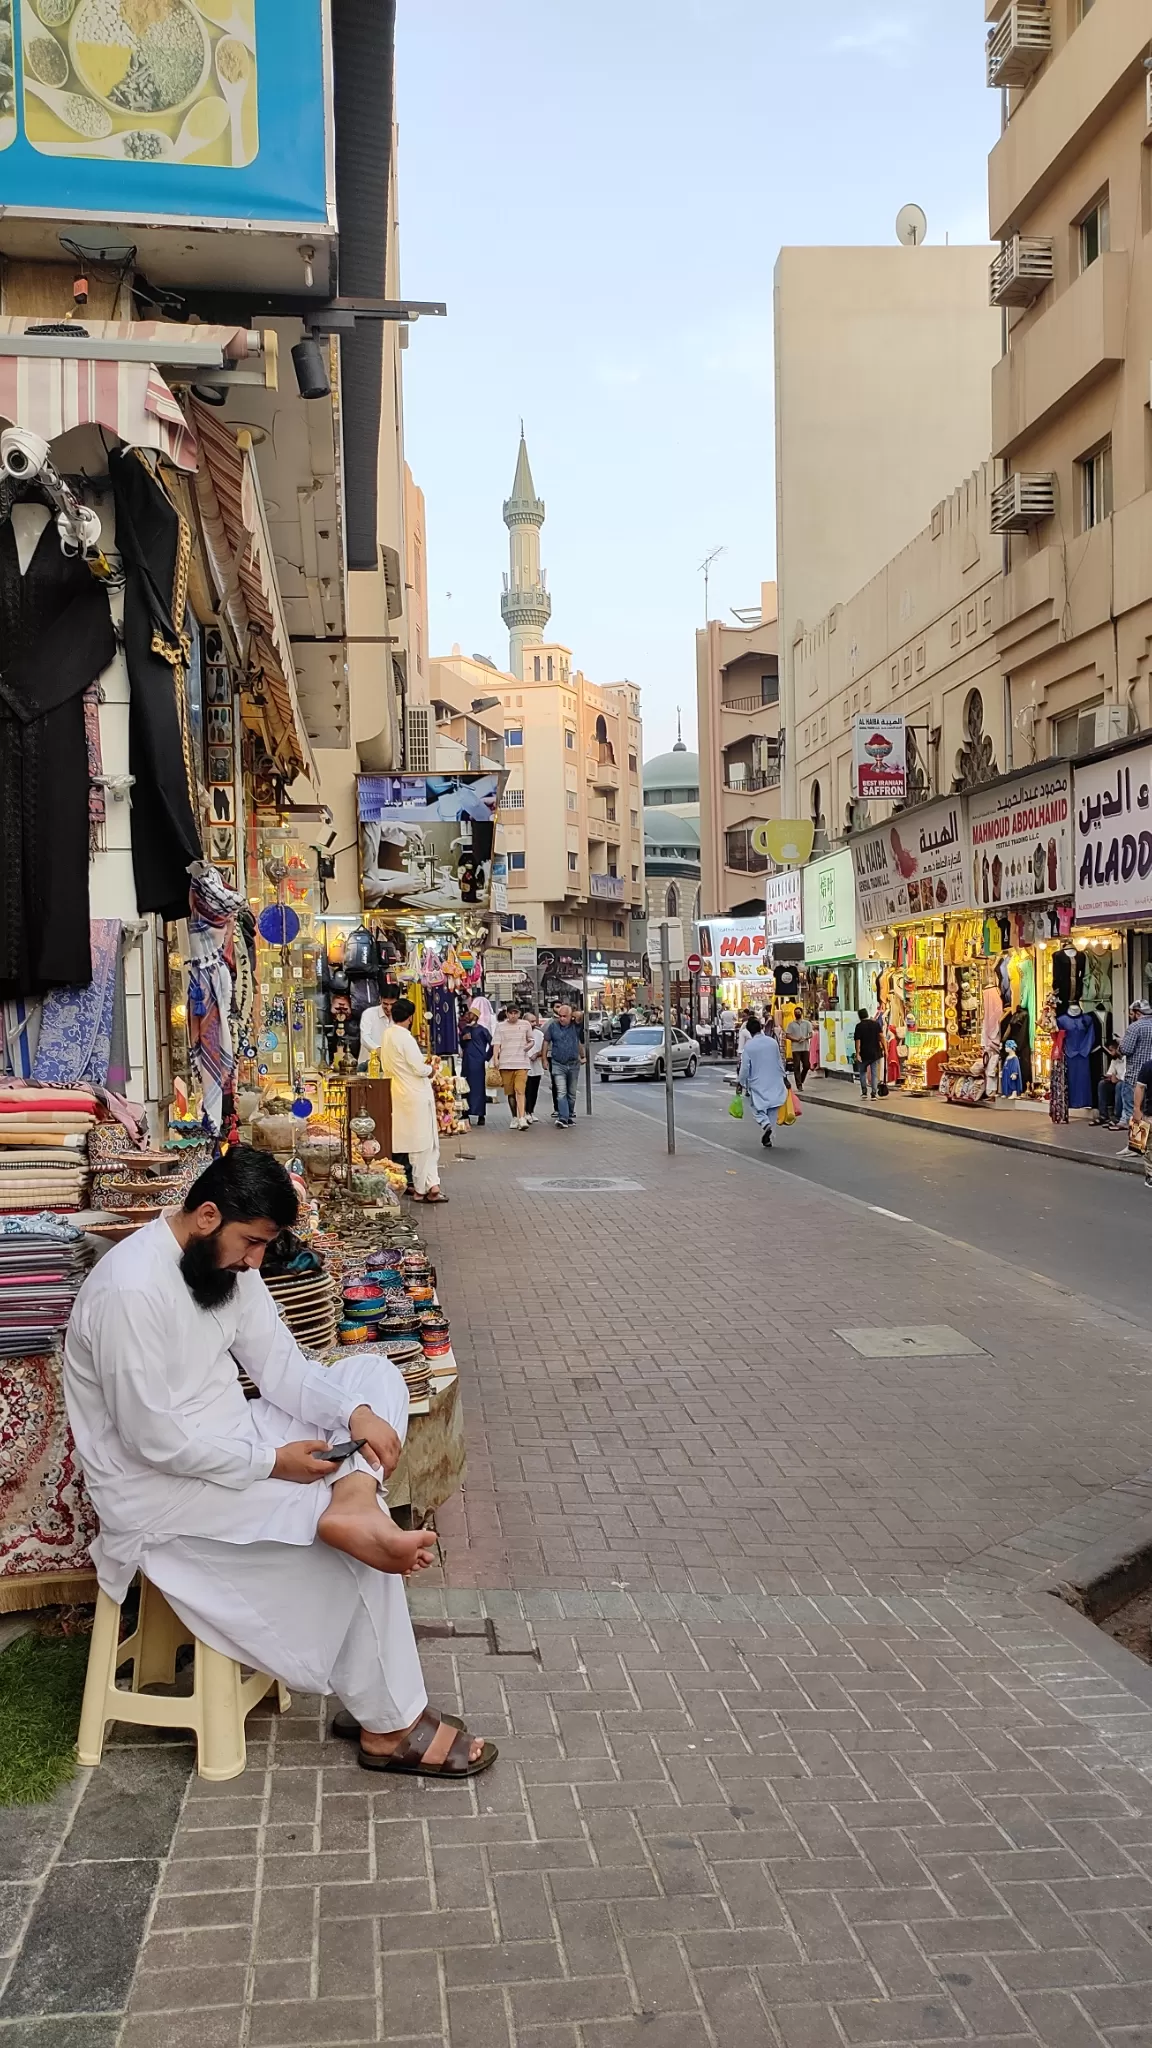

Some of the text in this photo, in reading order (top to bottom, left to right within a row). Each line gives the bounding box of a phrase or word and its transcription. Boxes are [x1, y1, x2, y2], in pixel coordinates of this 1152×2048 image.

[863, 786, 904, 795] SAFFRON
[878, 779, 904, 787] IRANIAN
[1040, 779, 1067, 798] محمود
[1079, 766, 1131, 837] الدين
[973, 798, 1068, 845] MAHMOUD ABDOLHAMID
[920, 810, 959, 856] الهيبة
[996, 840, 1011, 849] TEXTILE
[1011, 836, 1028, 846] TRADING
[855, 839, 888, 876] AL HAIBA
[1103, 900, 1118, 908] TRADING
